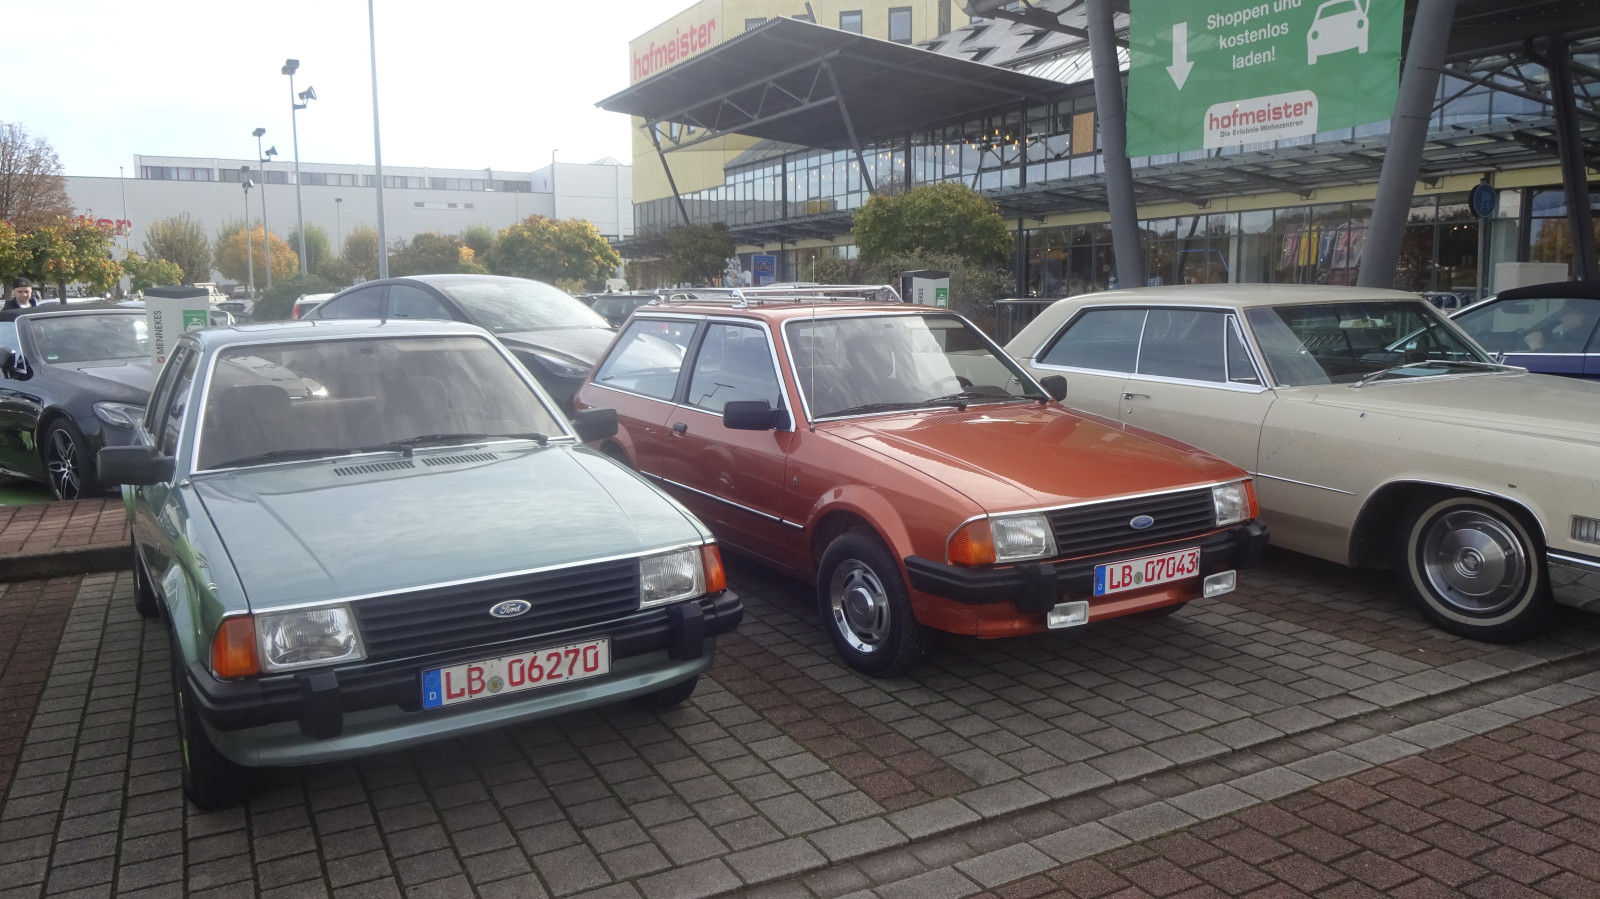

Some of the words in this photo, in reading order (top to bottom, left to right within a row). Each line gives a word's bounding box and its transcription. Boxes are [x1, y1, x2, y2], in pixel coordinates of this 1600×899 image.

[1206, 3, 1269, 30] Shoppen
[633, 18, 716, 81] hofmeister
[1219, 22, 1289, 50] kostenlos
[1232, 45, 1276, 70] laden!
[1208, 100, 1314, 131] hofmeister
[1220, 129, 1231, 138] Die
[1232, 120, 1304, 136] Erlebnis-Wohnzentren
[154, 310, 164, 354] MENNEKES
[1109, 564, 1133, 590] LB
[1144, 552, 1197, 583] 07043
[499, 602, 522, 615] Ford
[445, 665, 485, 700] LB
[508, 644, 599, 687] 06270
[429, 691, 437, 701] D
